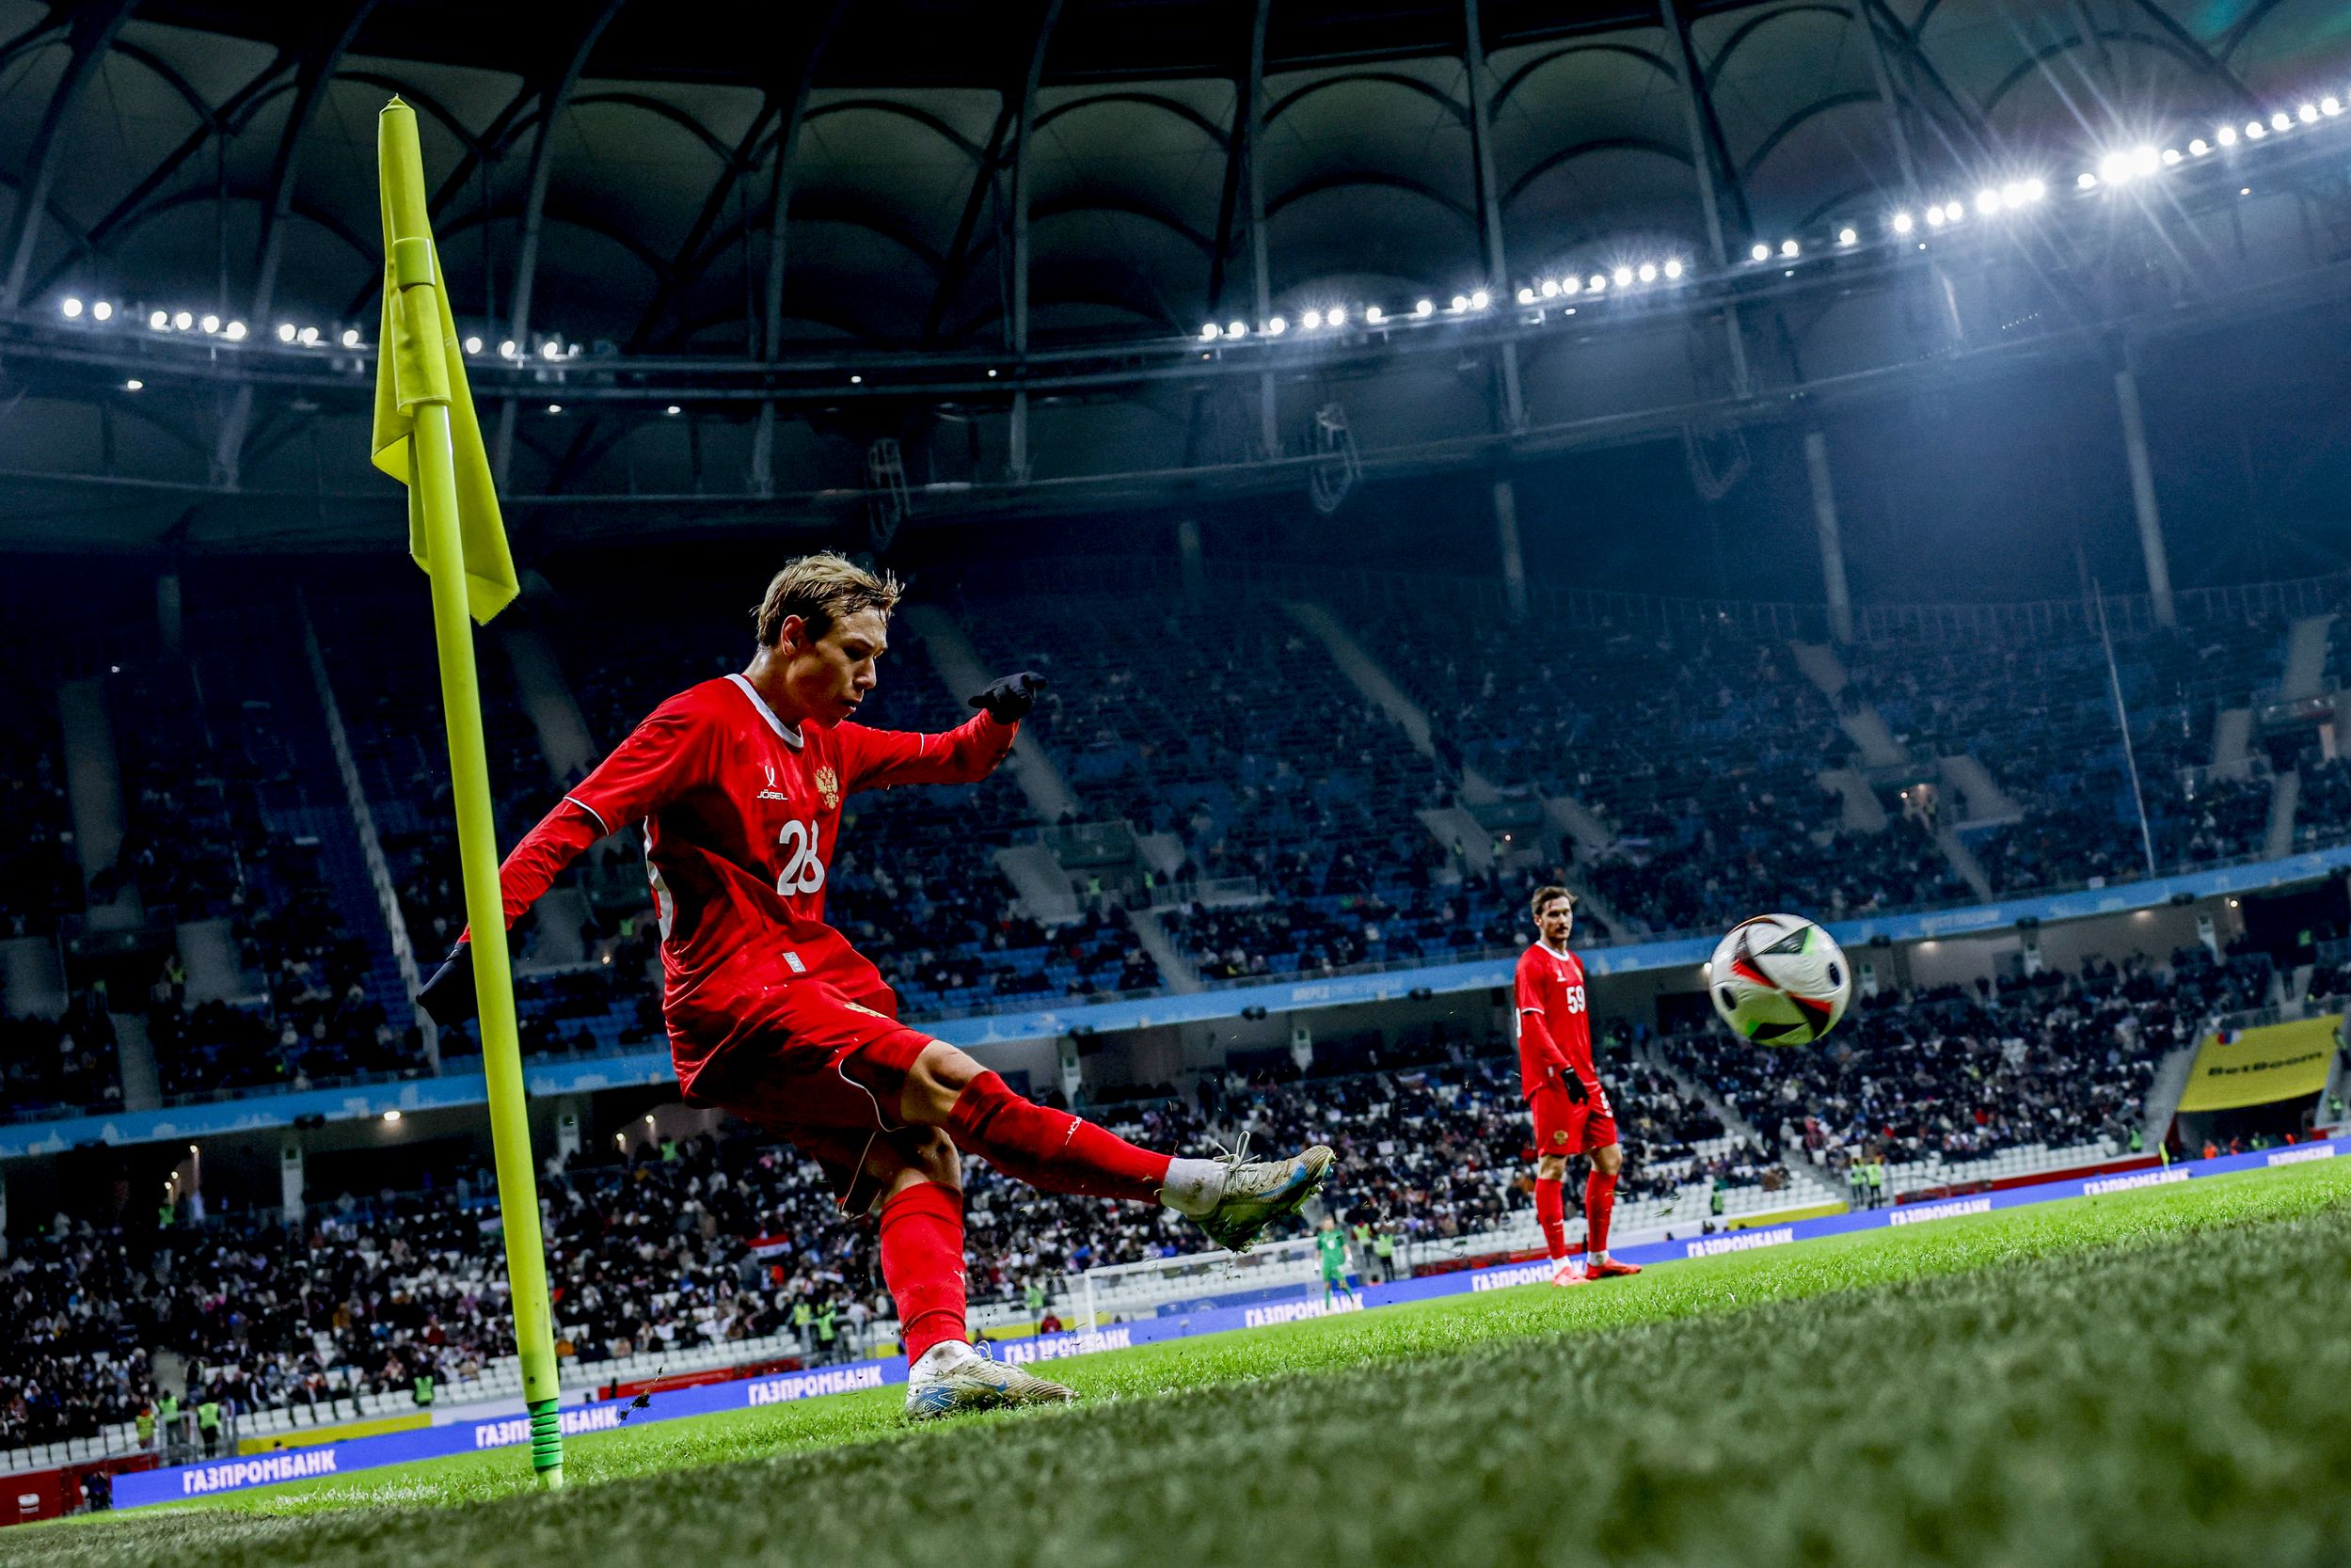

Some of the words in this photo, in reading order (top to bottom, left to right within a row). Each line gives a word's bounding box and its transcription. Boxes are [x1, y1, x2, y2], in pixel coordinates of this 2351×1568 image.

[756, 788, 789, 800] JÖGEL
[1565, 985, 1586, 1015] 59
[748, 1365, 883, 1406] ГАЗПРОМБАНК
[183, 1449, 337, 1494] ГАЗПРОМБАНК
